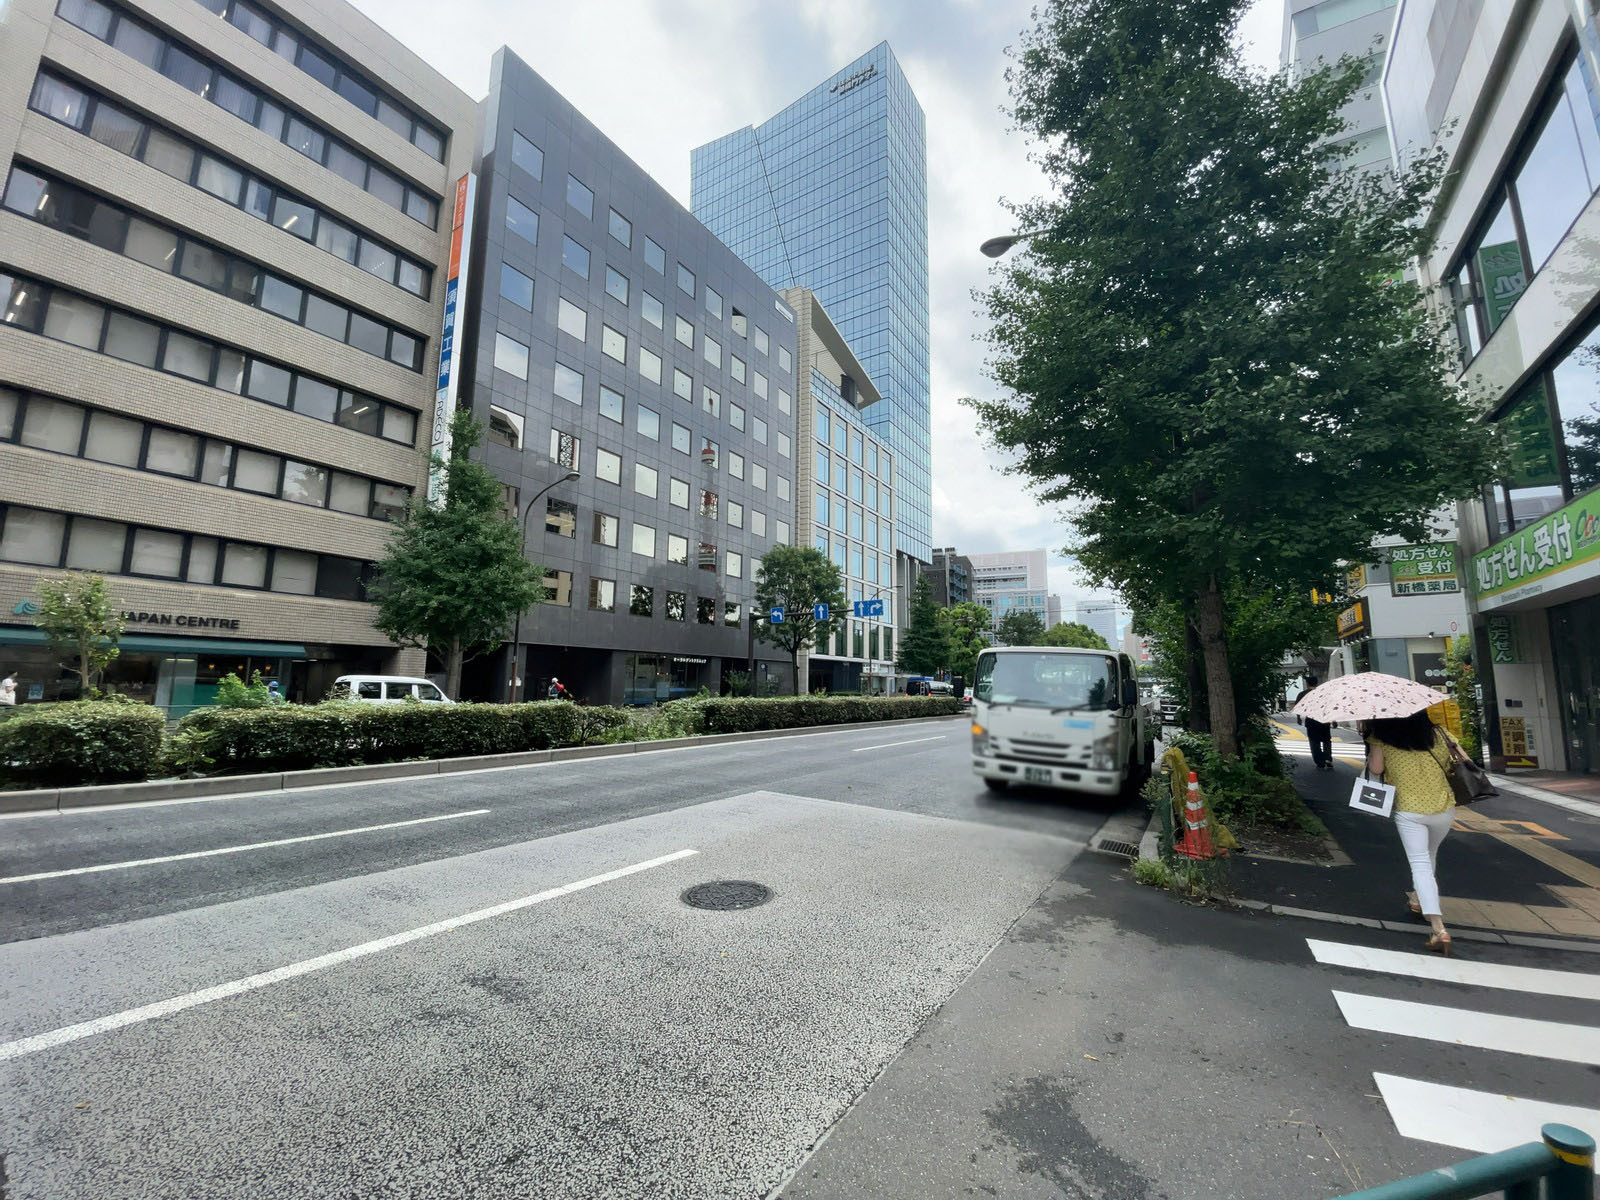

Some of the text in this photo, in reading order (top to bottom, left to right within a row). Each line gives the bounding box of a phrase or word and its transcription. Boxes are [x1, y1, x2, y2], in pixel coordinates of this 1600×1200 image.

[440, 288, 457, 377] 須賀工業
[434, 388, 448, 442] PADECO
[1392, 545, 1452, 562] 処方せん
[1476, 513, 1573, 592] 処方せん受付
[1417, 559, 1452, 575] 受付
[1397, 580, 1457, 593] 新橋薬局
[176, 615, 239, 629] CENTRE
[1490, 616, 1513, 662] 処方せん
[1502, 718, 1524, 727] FAX
